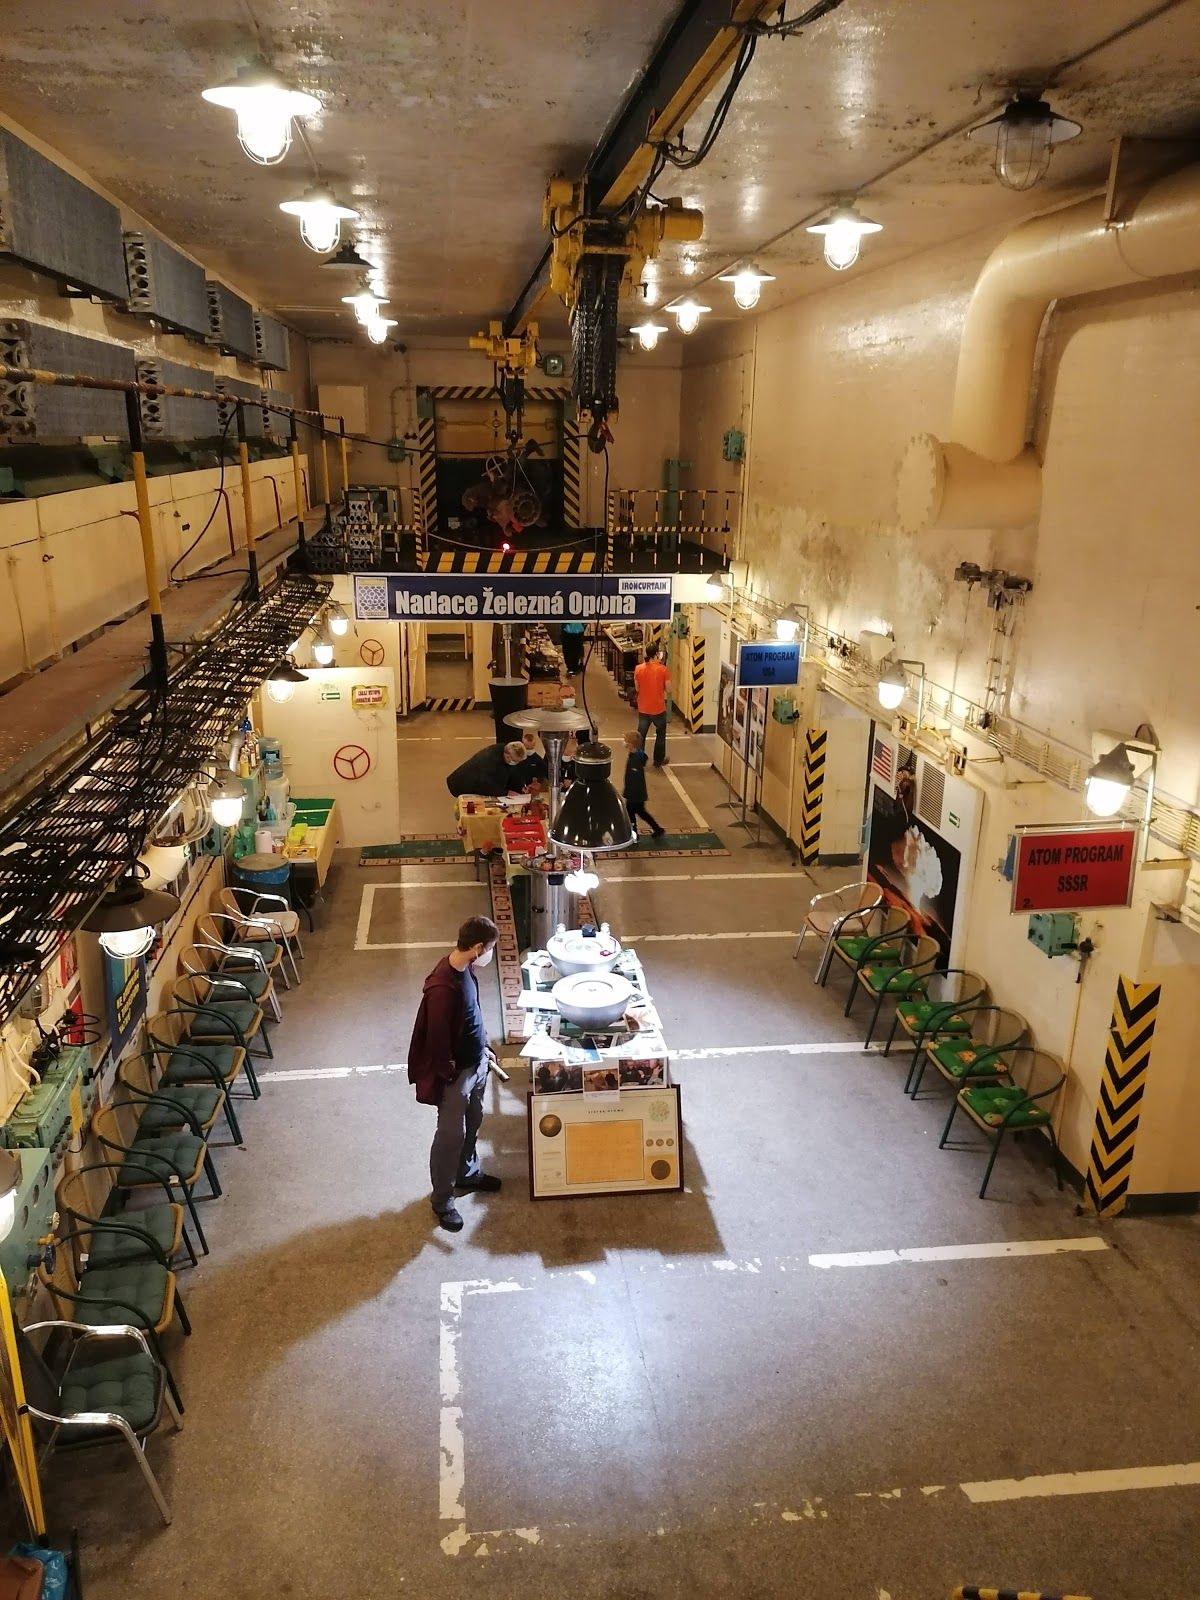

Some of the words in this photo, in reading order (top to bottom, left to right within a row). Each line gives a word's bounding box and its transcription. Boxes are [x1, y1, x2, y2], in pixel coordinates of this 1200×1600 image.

[621, 582, 667, 591] IRONCURTAIN
[395, 590, 478, 615] Nadace
[482, 586, 564, 615] Železná
[568, 591, 636, 617] Opona
[745, 652, 763, 662] ATOM
[764, 651, 796, 662] PROGRAM
[1028, 847, 1062, 866] ATOM
[1064, 844, 1125, 864] PROGRAM
[1057, 874, 1088, 893] SSSR
